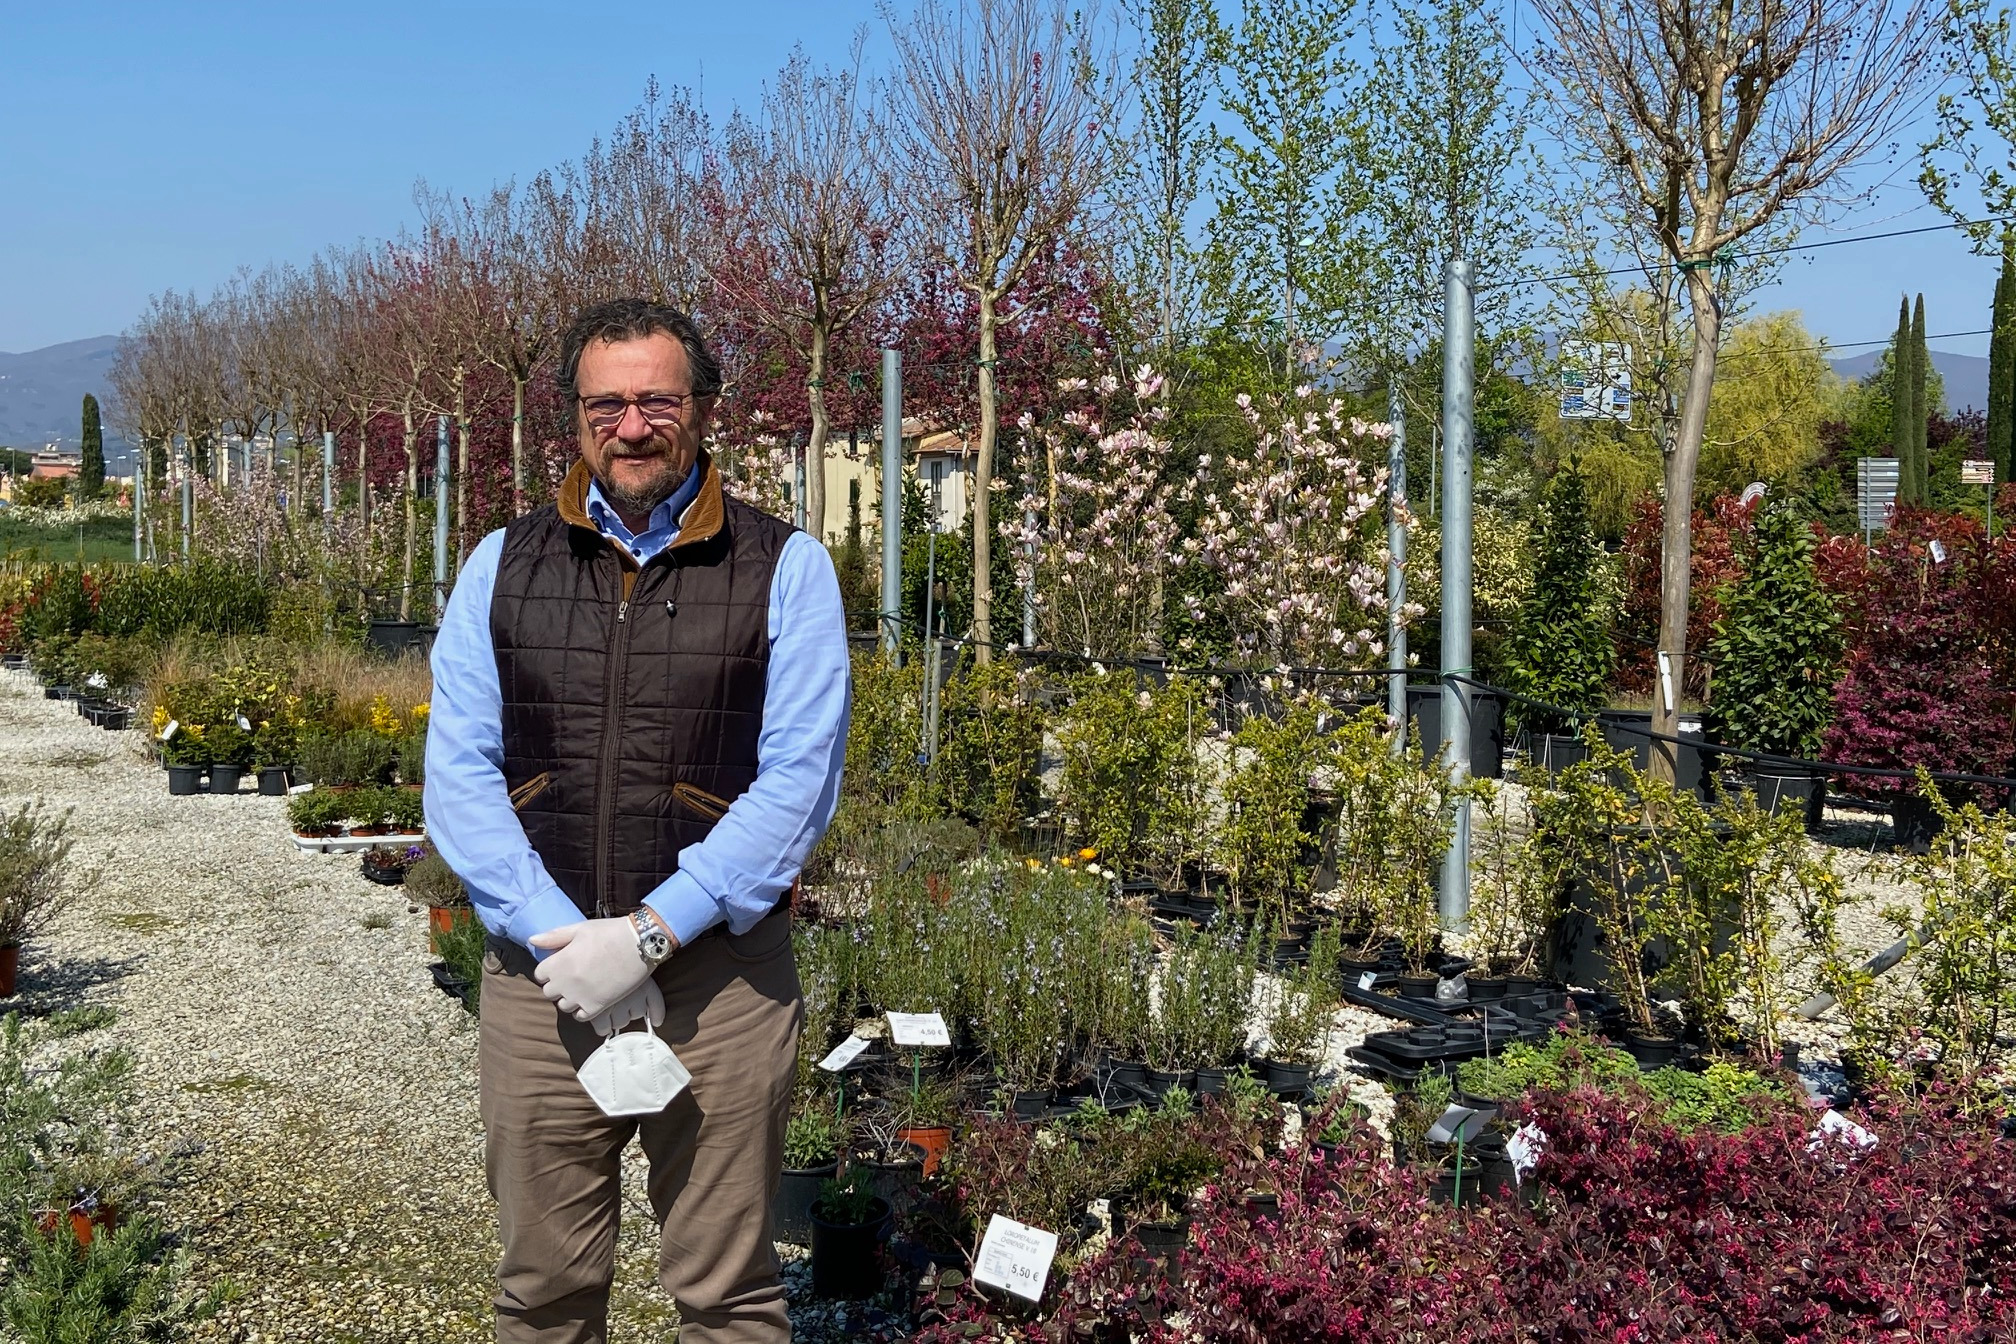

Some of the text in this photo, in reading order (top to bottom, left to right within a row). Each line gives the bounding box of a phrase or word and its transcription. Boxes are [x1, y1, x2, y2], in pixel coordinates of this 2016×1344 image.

[921, 1028, 936, 1036] 4,50
[1011, 1264, 1039, 1282] 5,50 €
